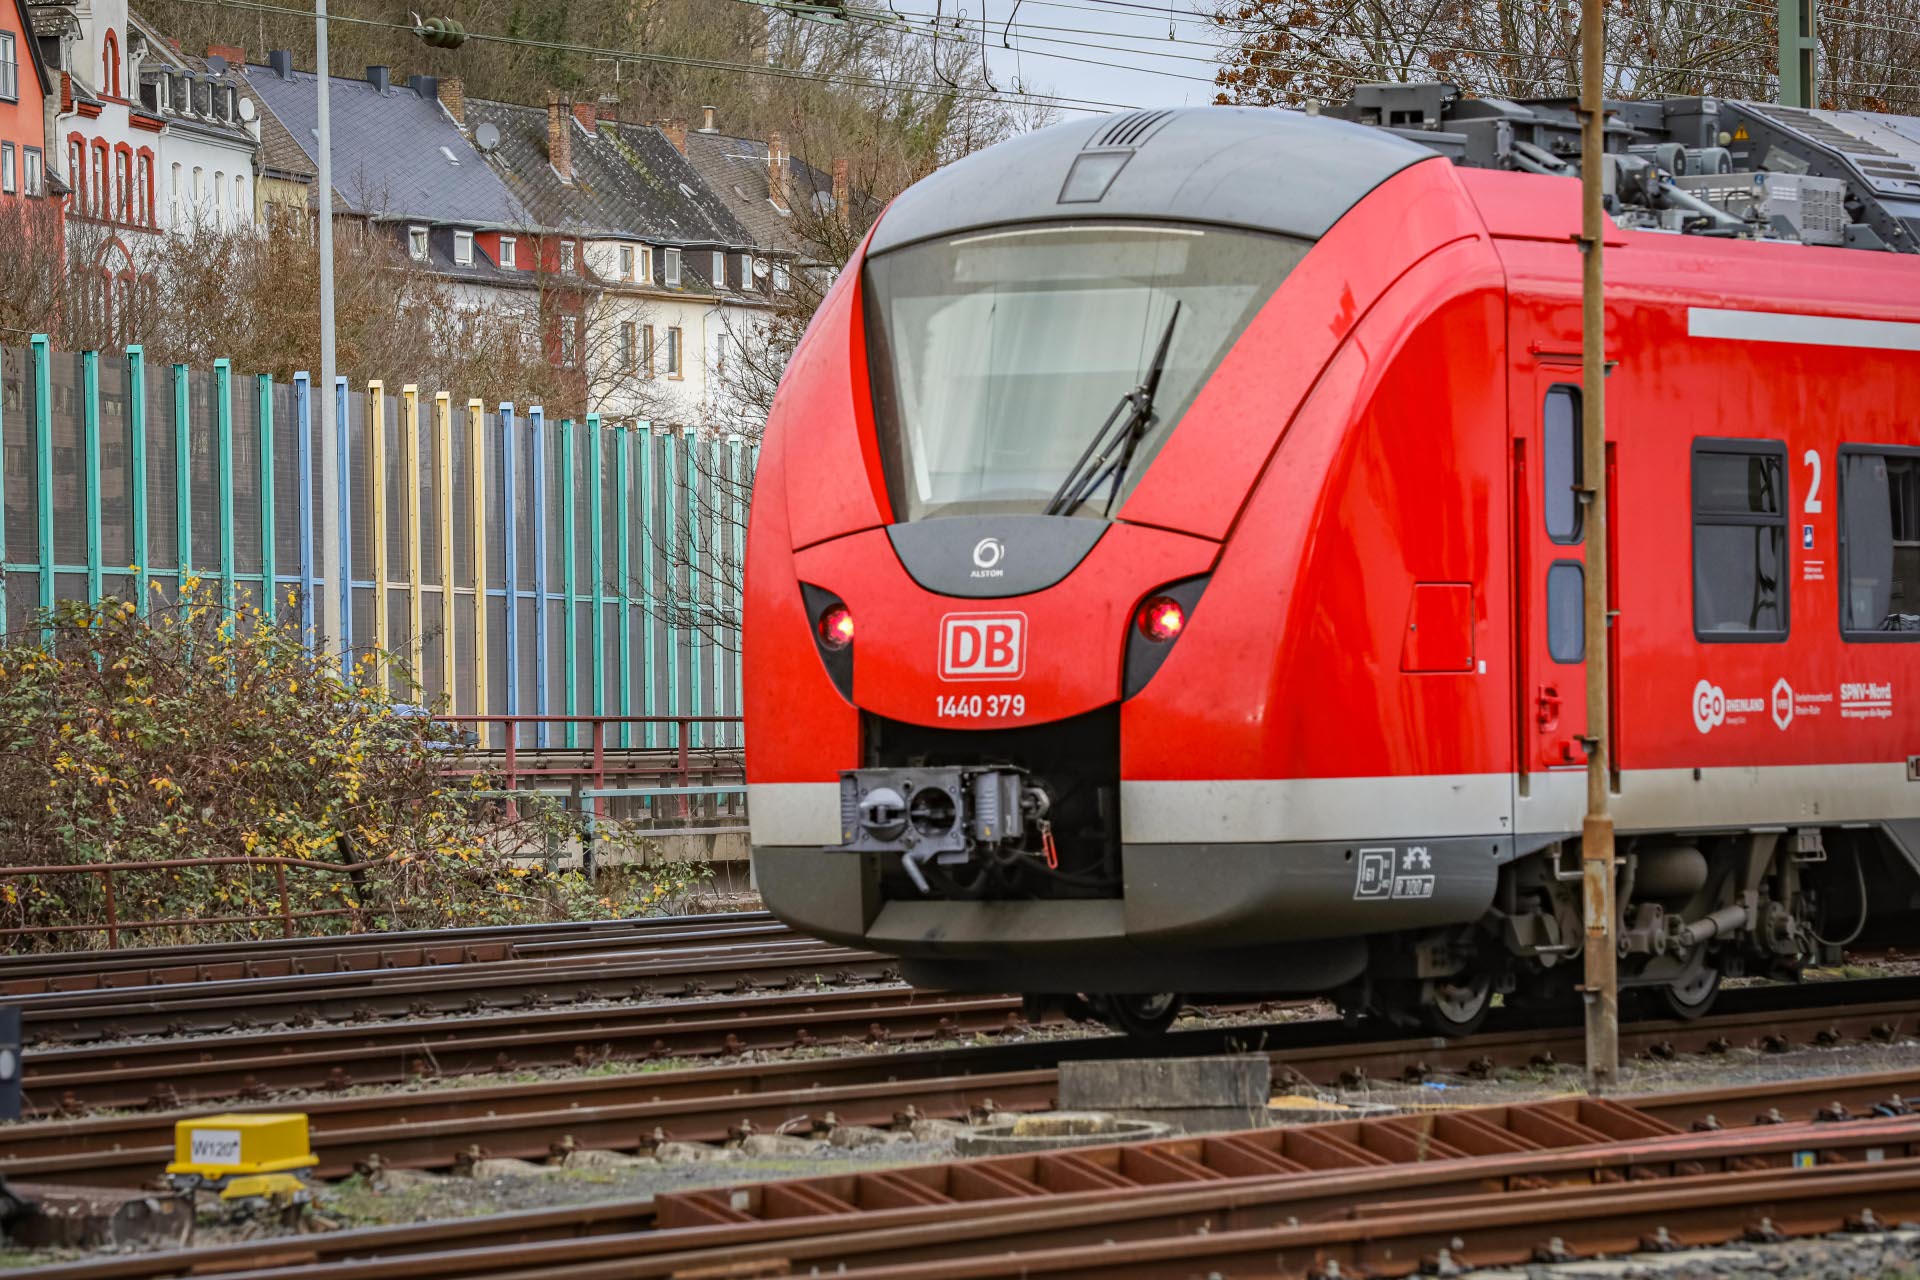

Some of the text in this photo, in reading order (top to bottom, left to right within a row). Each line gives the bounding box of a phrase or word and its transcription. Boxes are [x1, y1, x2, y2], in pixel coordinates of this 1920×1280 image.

[1804, 449, 1822, 513] 2
[970, 569, 1004, 578] ALSTOM
[951, 624, 1015, 669] DB
[1841, 682, 1892, 701] SPNV-Nord
[936, 694, 1026, 718] 1440 379
